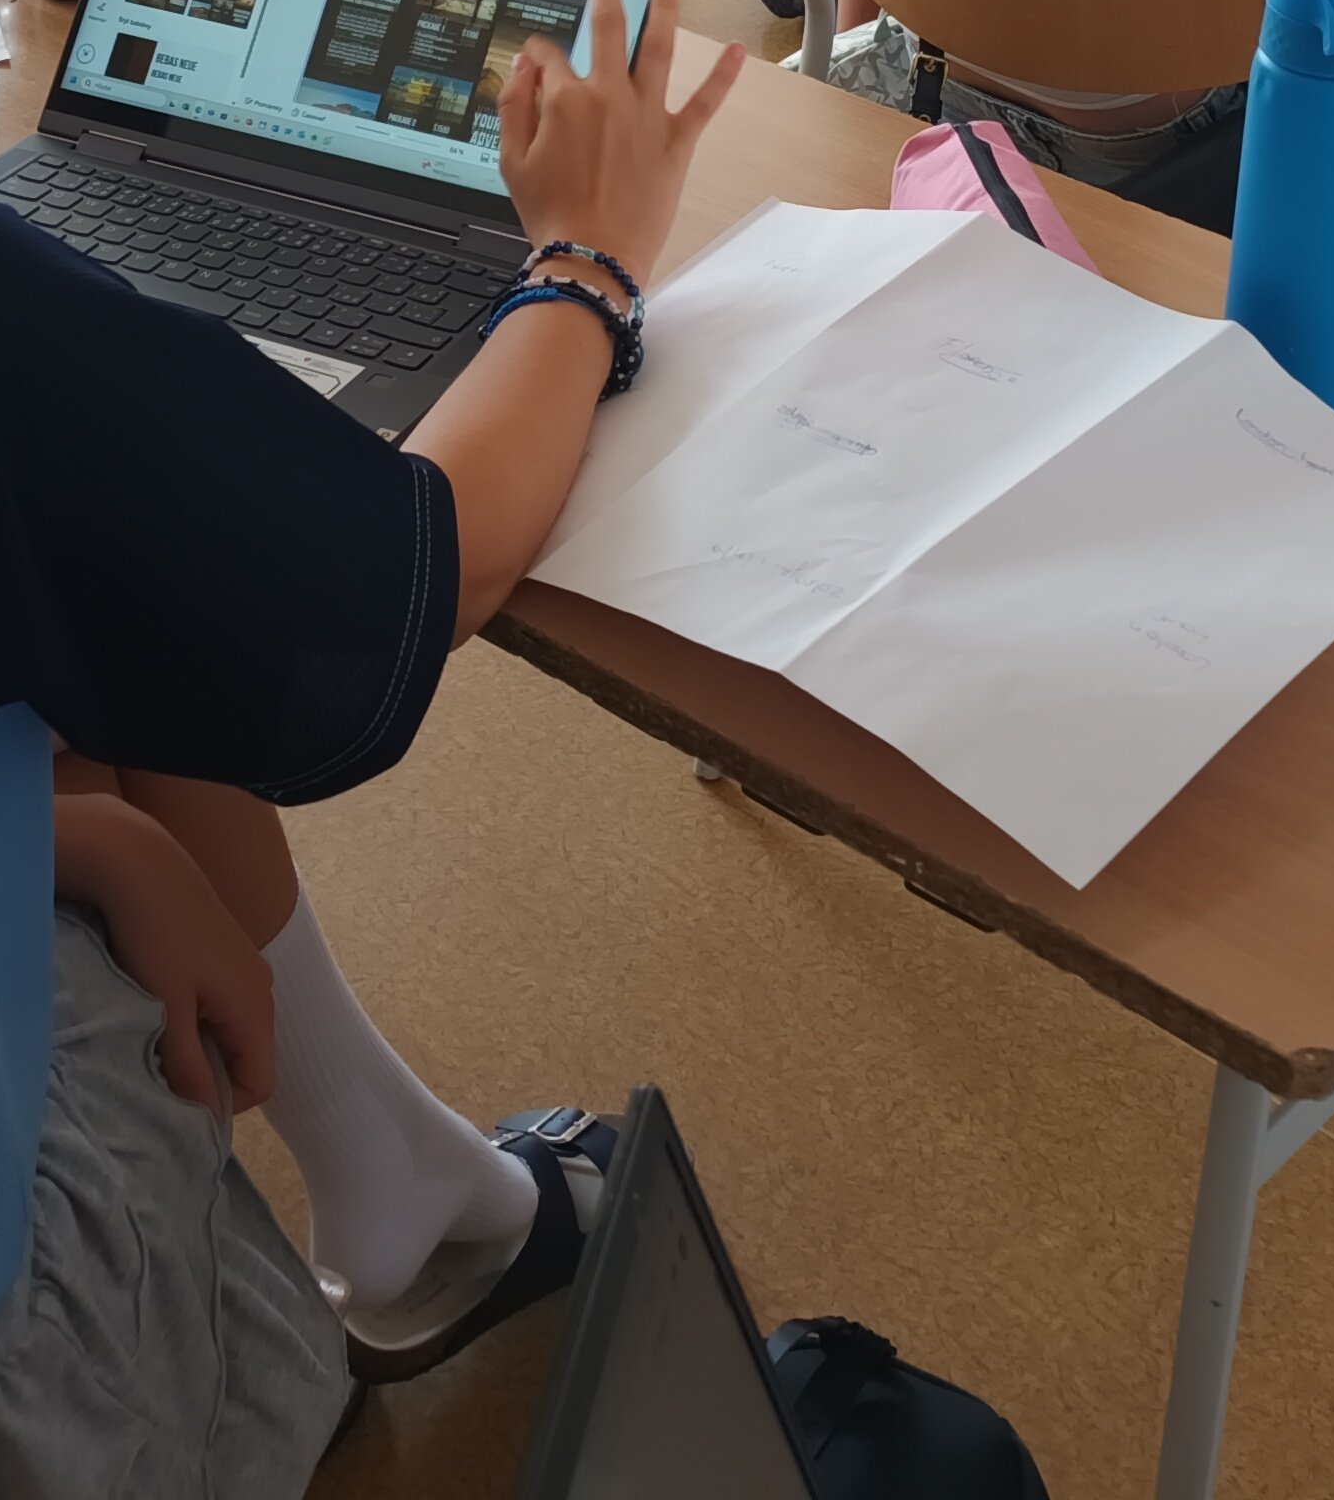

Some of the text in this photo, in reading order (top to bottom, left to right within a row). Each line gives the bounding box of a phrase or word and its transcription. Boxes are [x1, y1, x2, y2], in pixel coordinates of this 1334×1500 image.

[155, 52, 199, 72] BEBAS NEUE
[469, 130, 501, 150] ADVE
